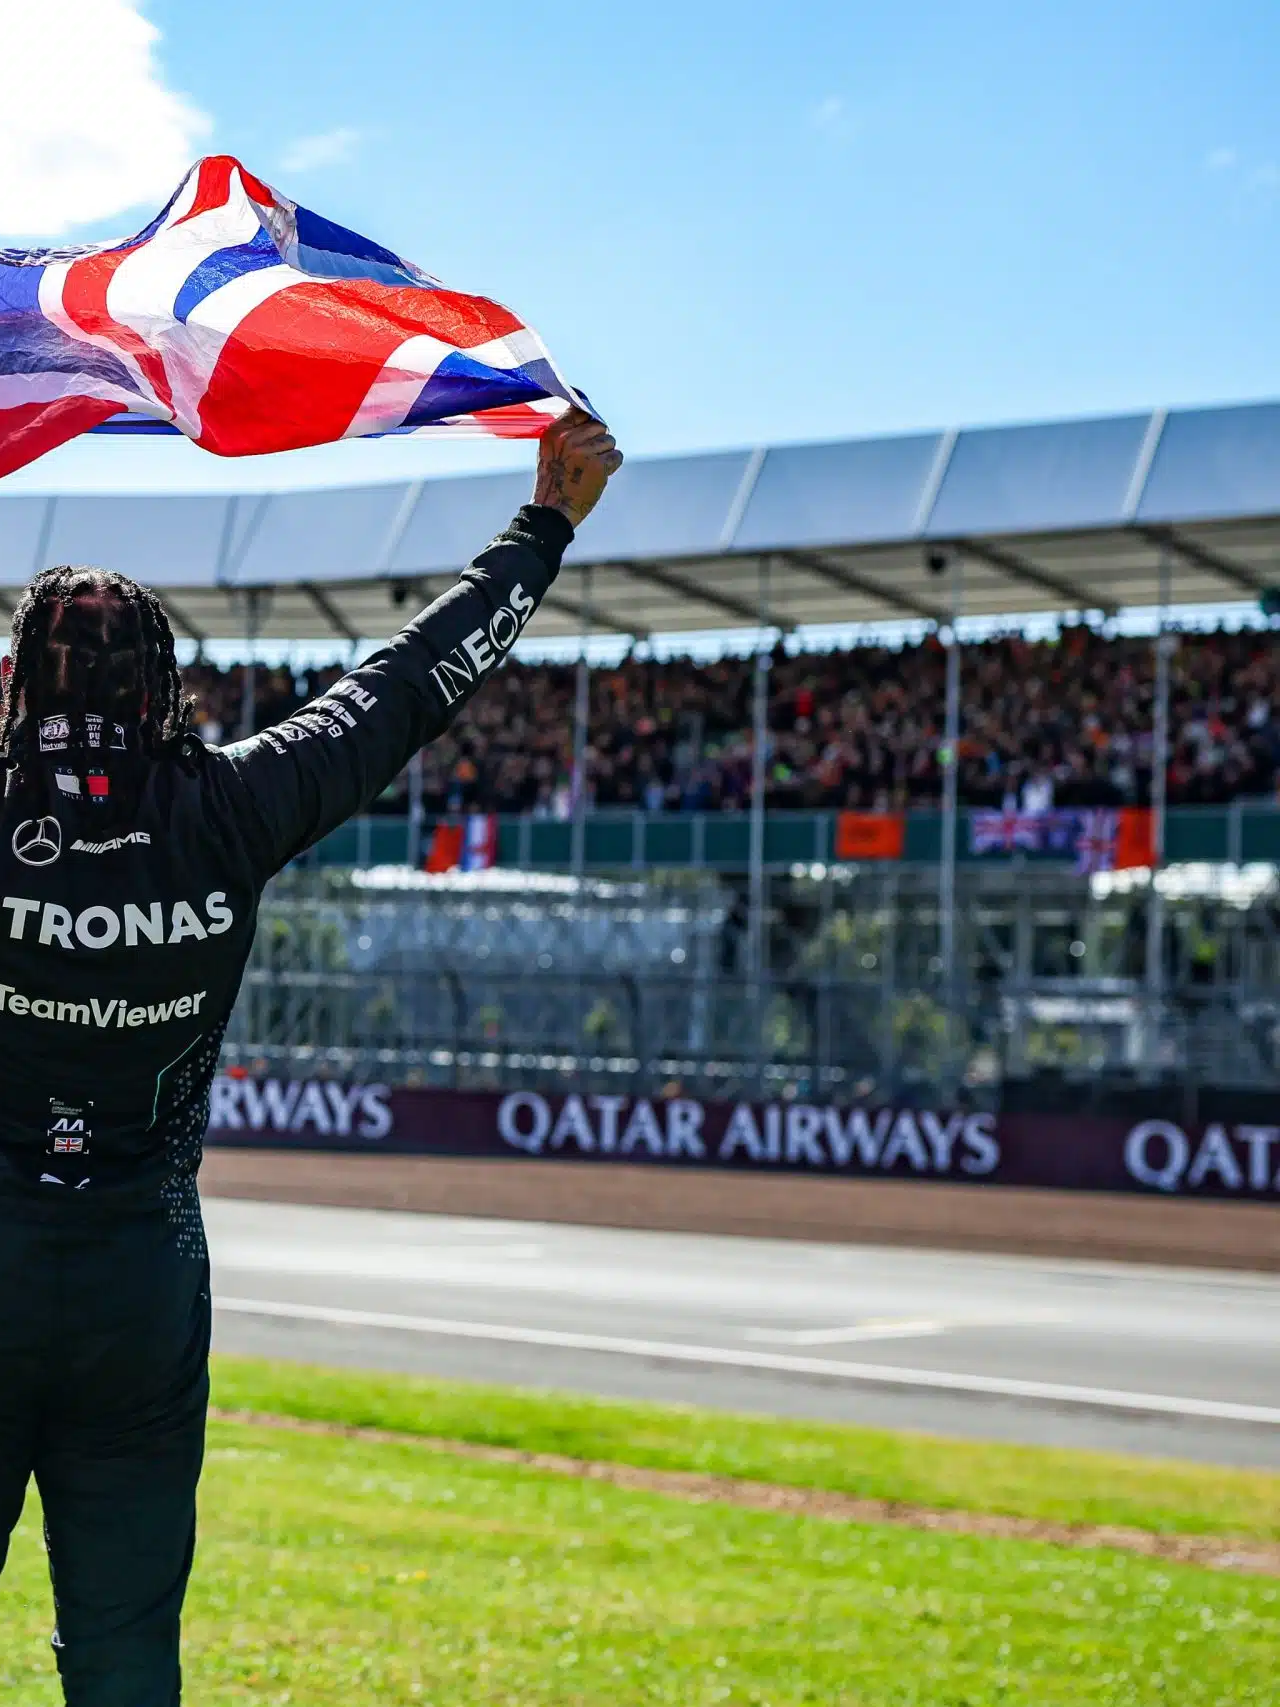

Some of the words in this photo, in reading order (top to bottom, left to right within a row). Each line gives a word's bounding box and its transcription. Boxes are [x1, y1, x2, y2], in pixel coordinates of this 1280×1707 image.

[428, 582, 535, 706] INEOS
[42, 720, 70, 738] FIA
[209, 1076, 394, 1139] RWAYS
[497, 1090, 706, 1158] QATAR
[720, 1100, 1001, 1175] AIRWAYS
[1123, 1119, 1280, 1191] QAT
